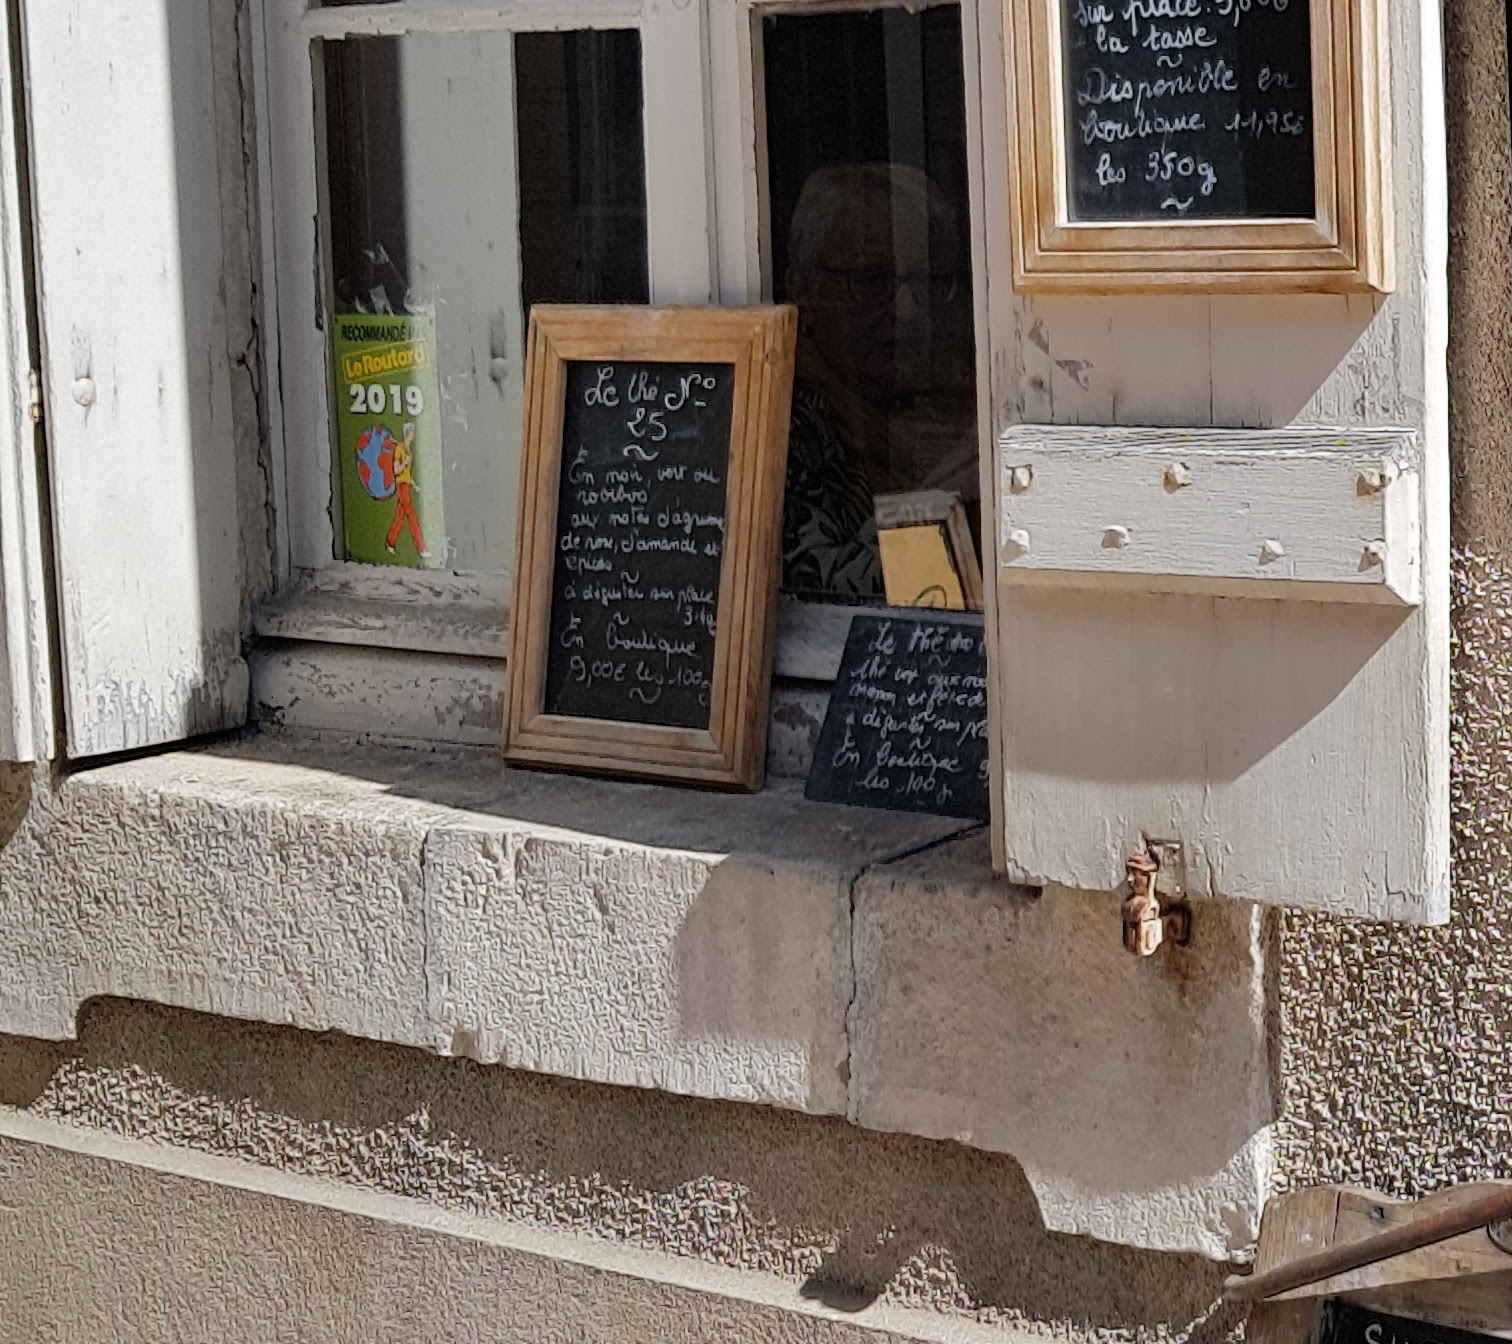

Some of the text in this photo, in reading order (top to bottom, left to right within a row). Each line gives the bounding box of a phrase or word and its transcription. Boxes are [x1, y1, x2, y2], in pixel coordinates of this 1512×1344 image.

[1095, 23, 1218, 53] la tasse
[1078, 58, 1238, 118] Disponible
[1079, 108, 1206, 155] boutique
[1096, 150, 1218, 196] les 350g
[350, 383, 423, 416] 2019
[584, 366, 619, 406] Le
[628, 371, 660, 403] thé
[627, 407, 668, 441] 25
[560, 531, 581, 551] de
[606, 622, 703, 670] boutique
